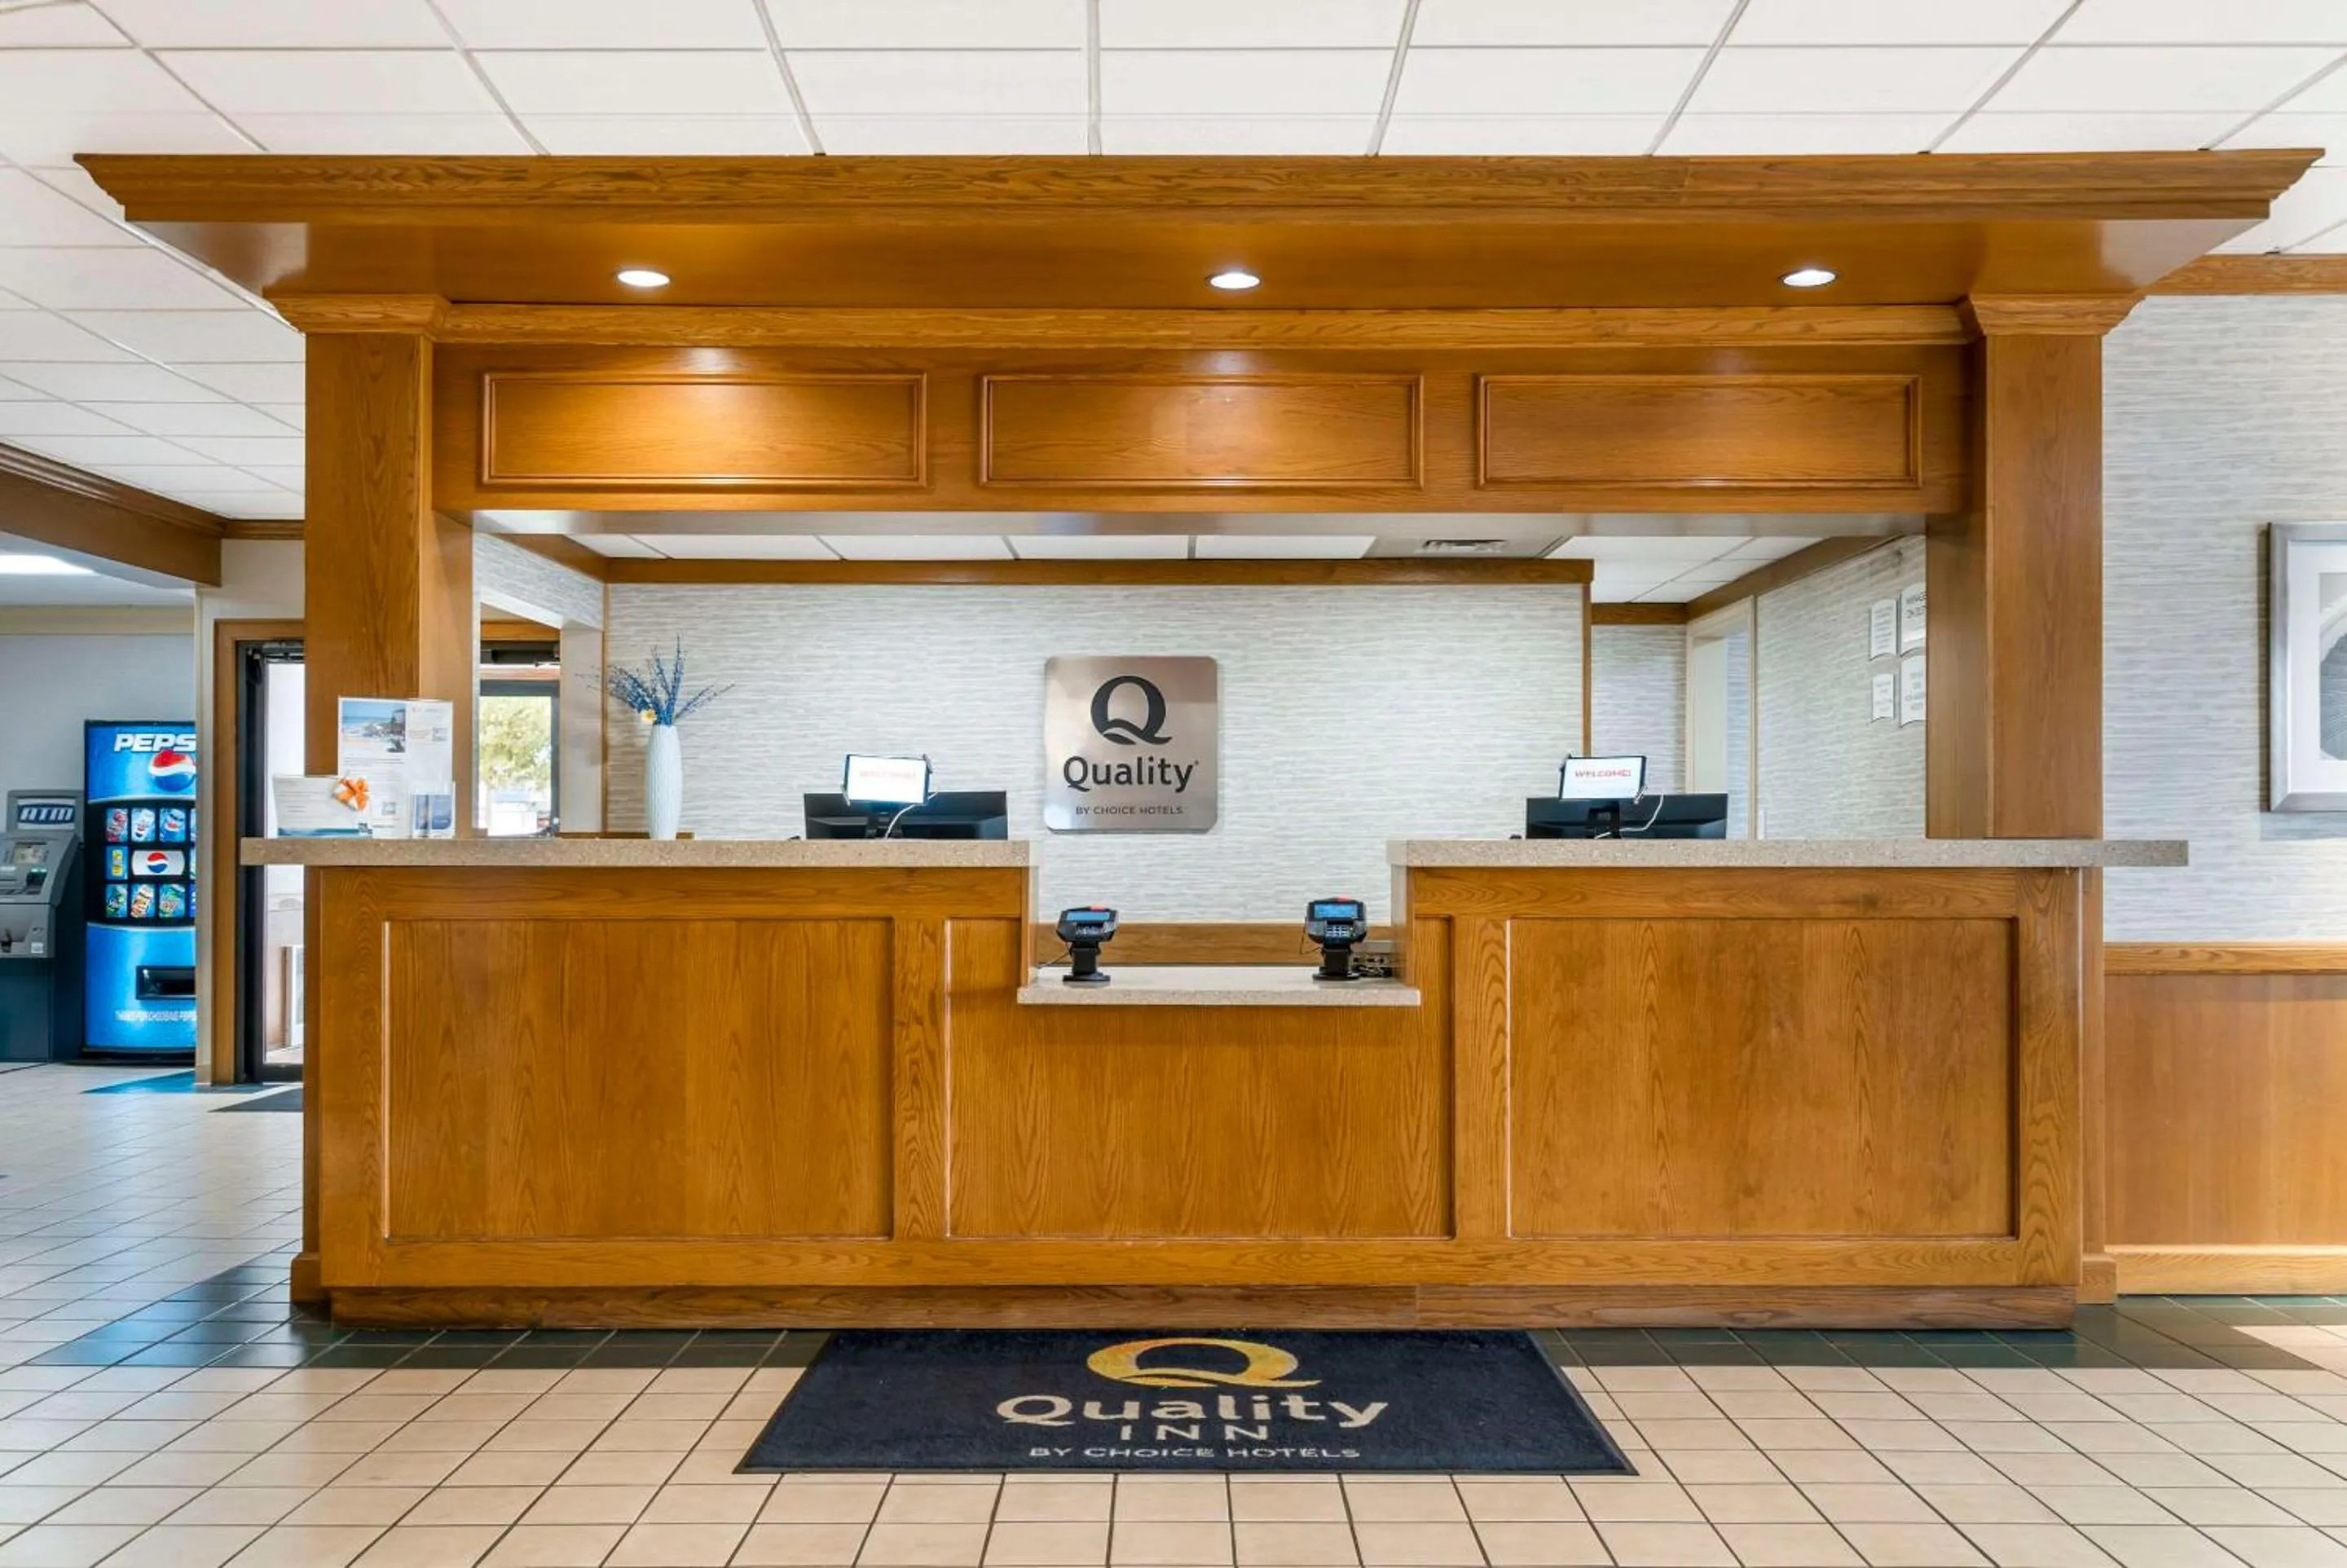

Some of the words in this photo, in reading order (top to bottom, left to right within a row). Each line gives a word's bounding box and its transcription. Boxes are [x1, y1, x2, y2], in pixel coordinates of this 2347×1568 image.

[1090, 675, 1173, 746] Q
[113, 733, 196, 752] PEPS
[1063, 755, 1194, 793] Quality
[20, 806, 74, 821] ATM
[1075, 805, 1090, 816] BY
[1093, 805, 1136, 816] CHOICE
[1139, 805, 1184, 816] HOTELS
[1086, 1337, 1323, 1388] Q
[995, 1394, 1389, 1429] Quality
[1119, 1425, 1270, 1441] INN
[1028, 1447, 1073, 1458] BY
[1083, 1447, 1216, 1458] CHOICE
[1226, 1447, 1360, 1459] HOTELS
